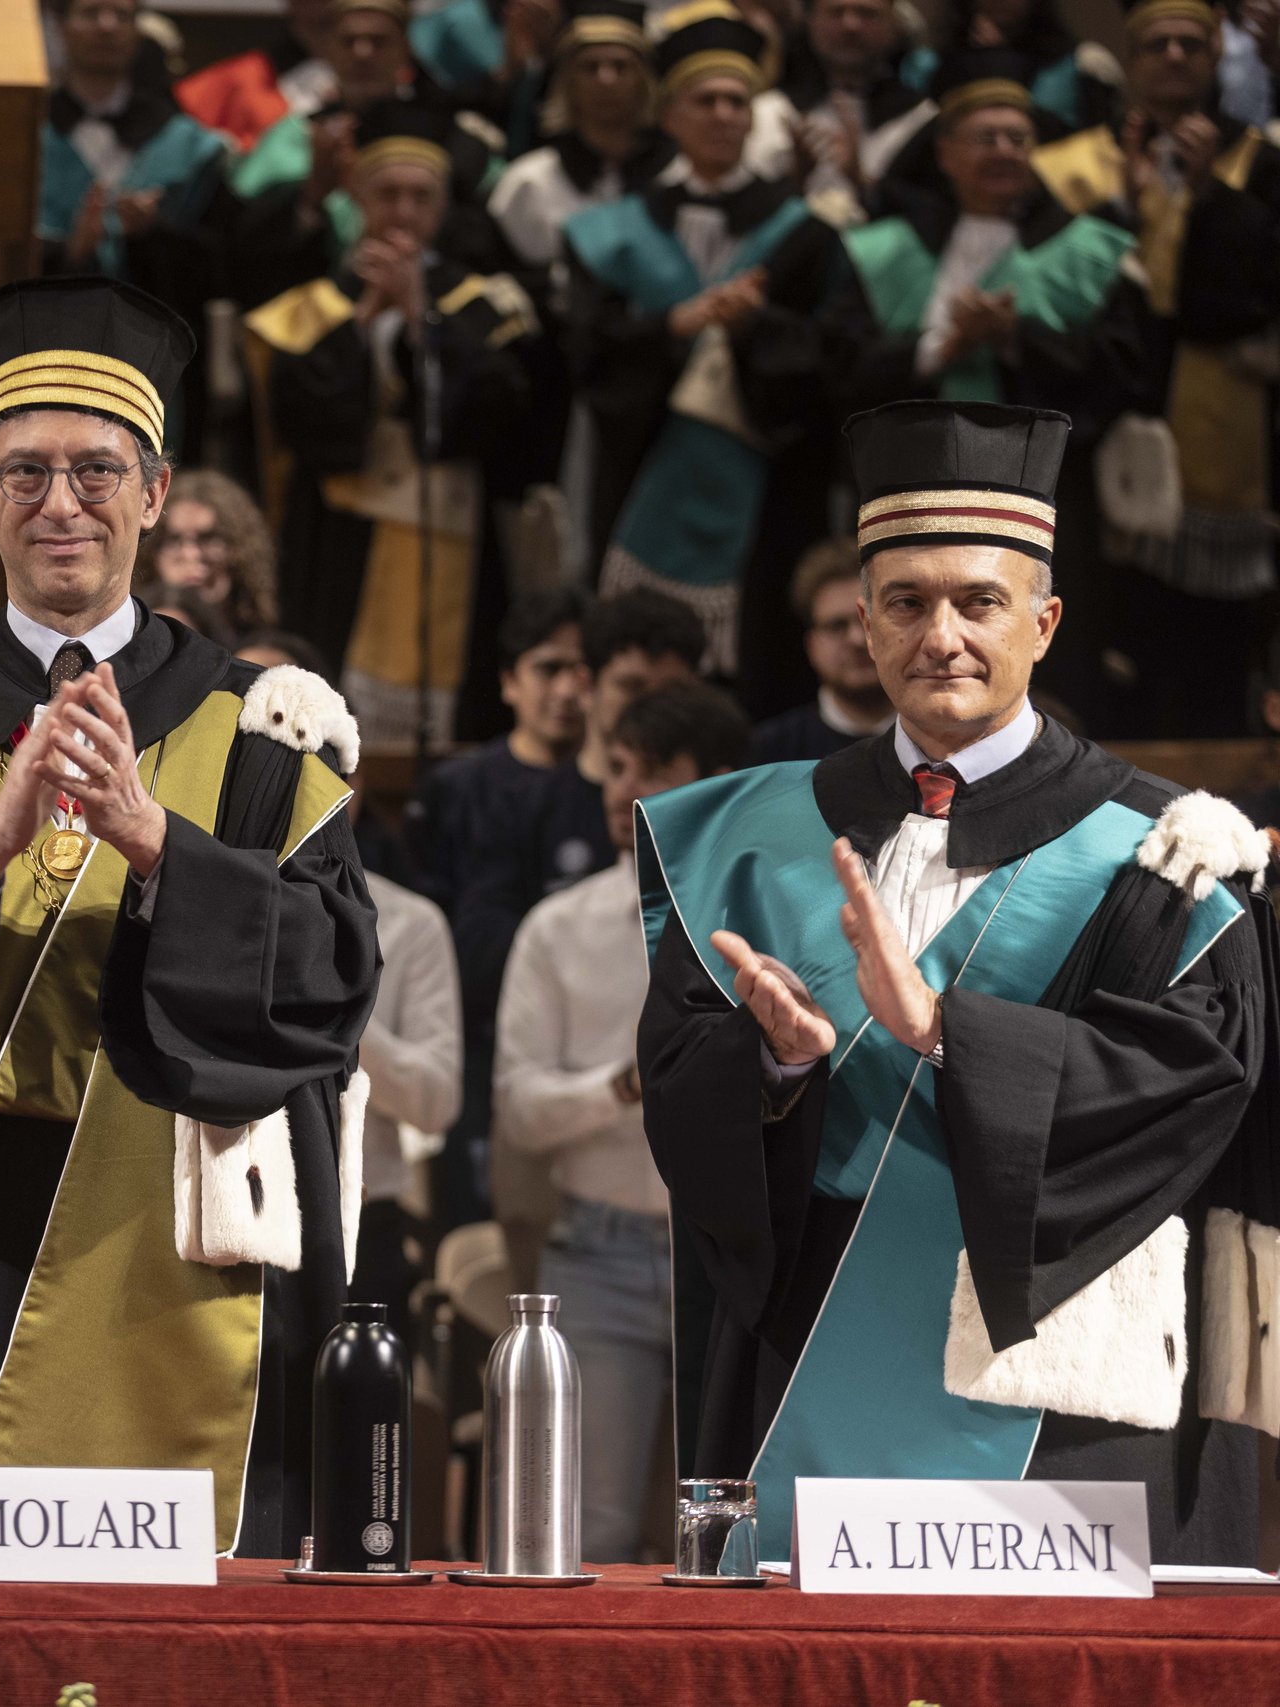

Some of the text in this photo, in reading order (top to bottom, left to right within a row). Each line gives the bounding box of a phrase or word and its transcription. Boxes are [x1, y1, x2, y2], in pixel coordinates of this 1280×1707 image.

[379, 1462, 387, 1472] DI
[392, 1423, 400, 1521] Multicampus Sostenibile
[544, 1428, 552, 1525] Multicampus Sostenibile
[828, 1520, 1118, 1572] A. LIVERANI
